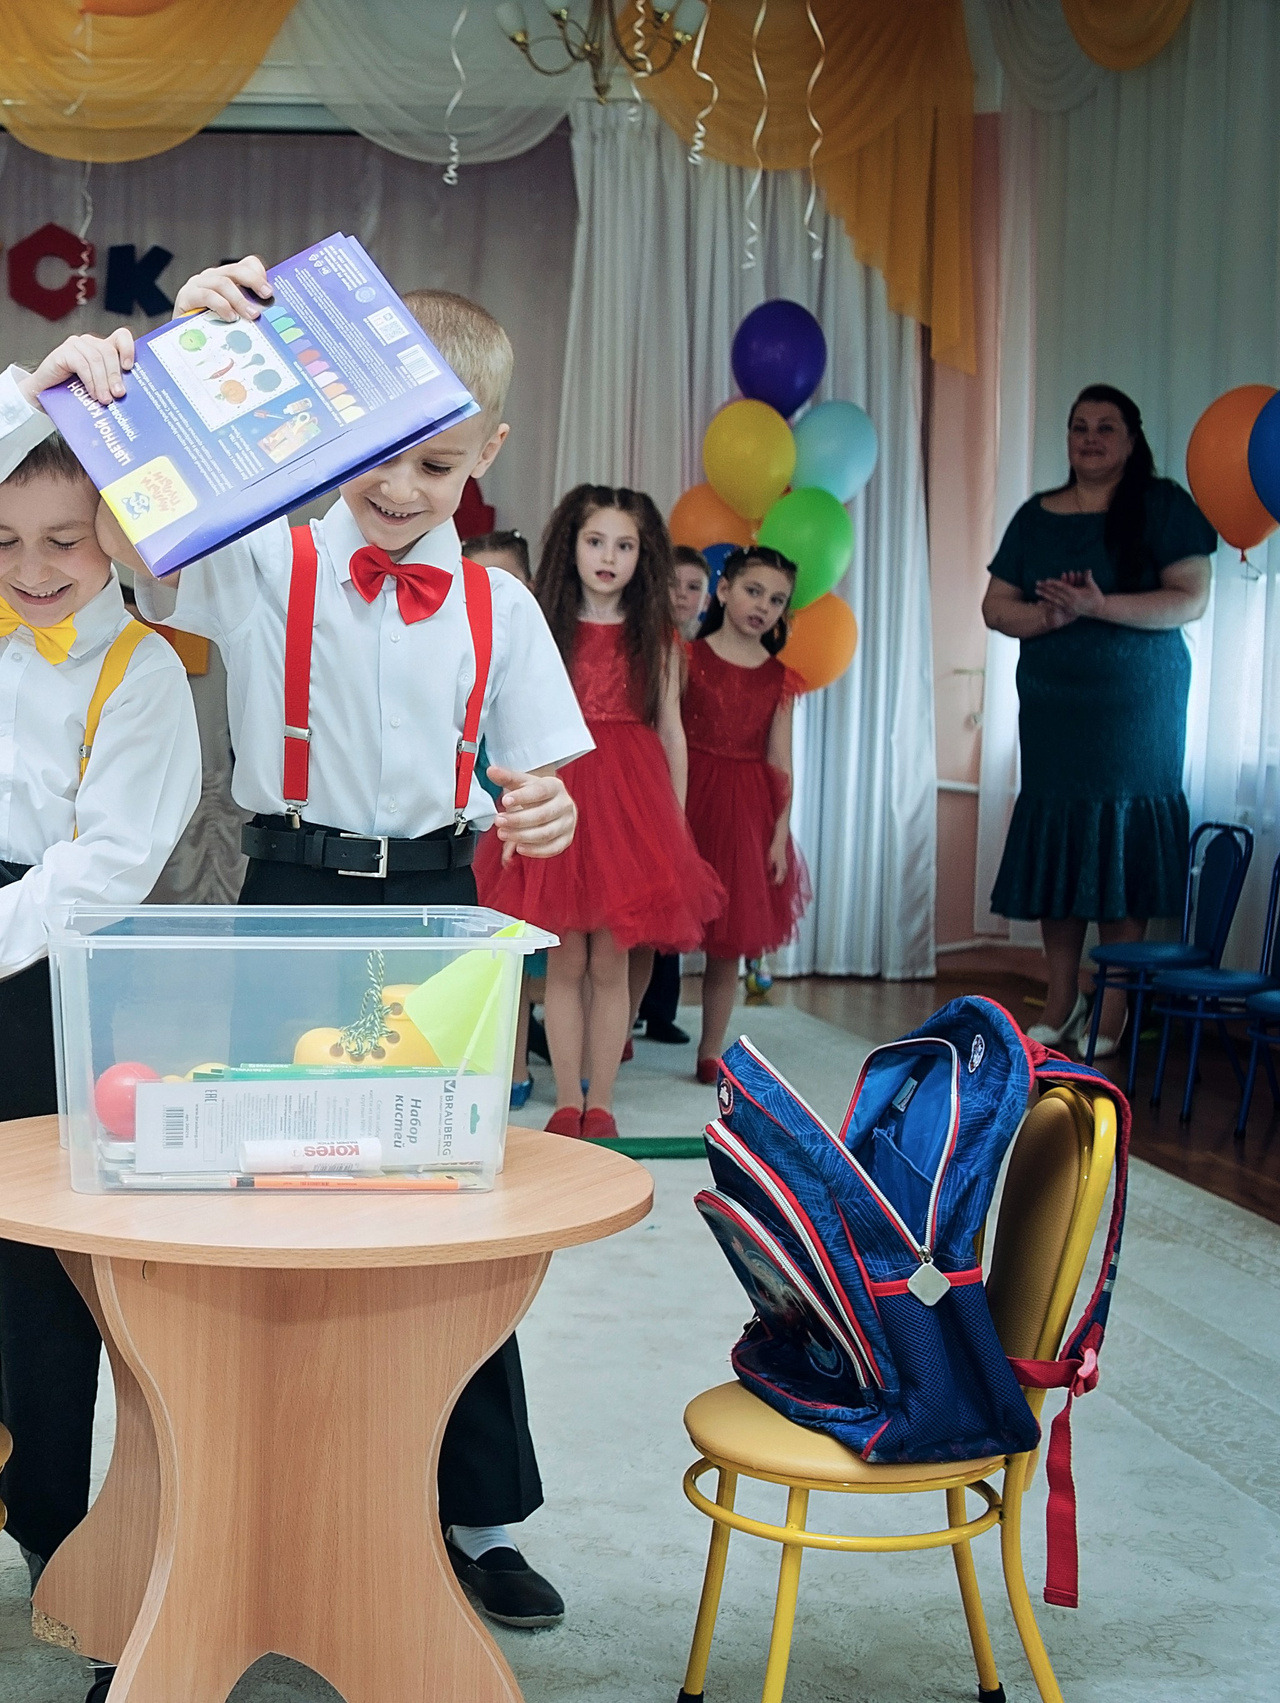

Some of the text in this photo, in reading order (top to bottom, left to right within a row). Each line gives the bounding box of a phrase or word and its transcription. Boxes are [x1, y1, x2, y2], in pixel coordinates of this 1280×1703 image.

[67, 378, 132, 466] ЦВЕТНОЙ КАРТОН
[392, 1094, 404, 1148] кистей
[406, 1098, 421, 1143] Набор
[442, 1095, 453, 1156] BRAUBERG
